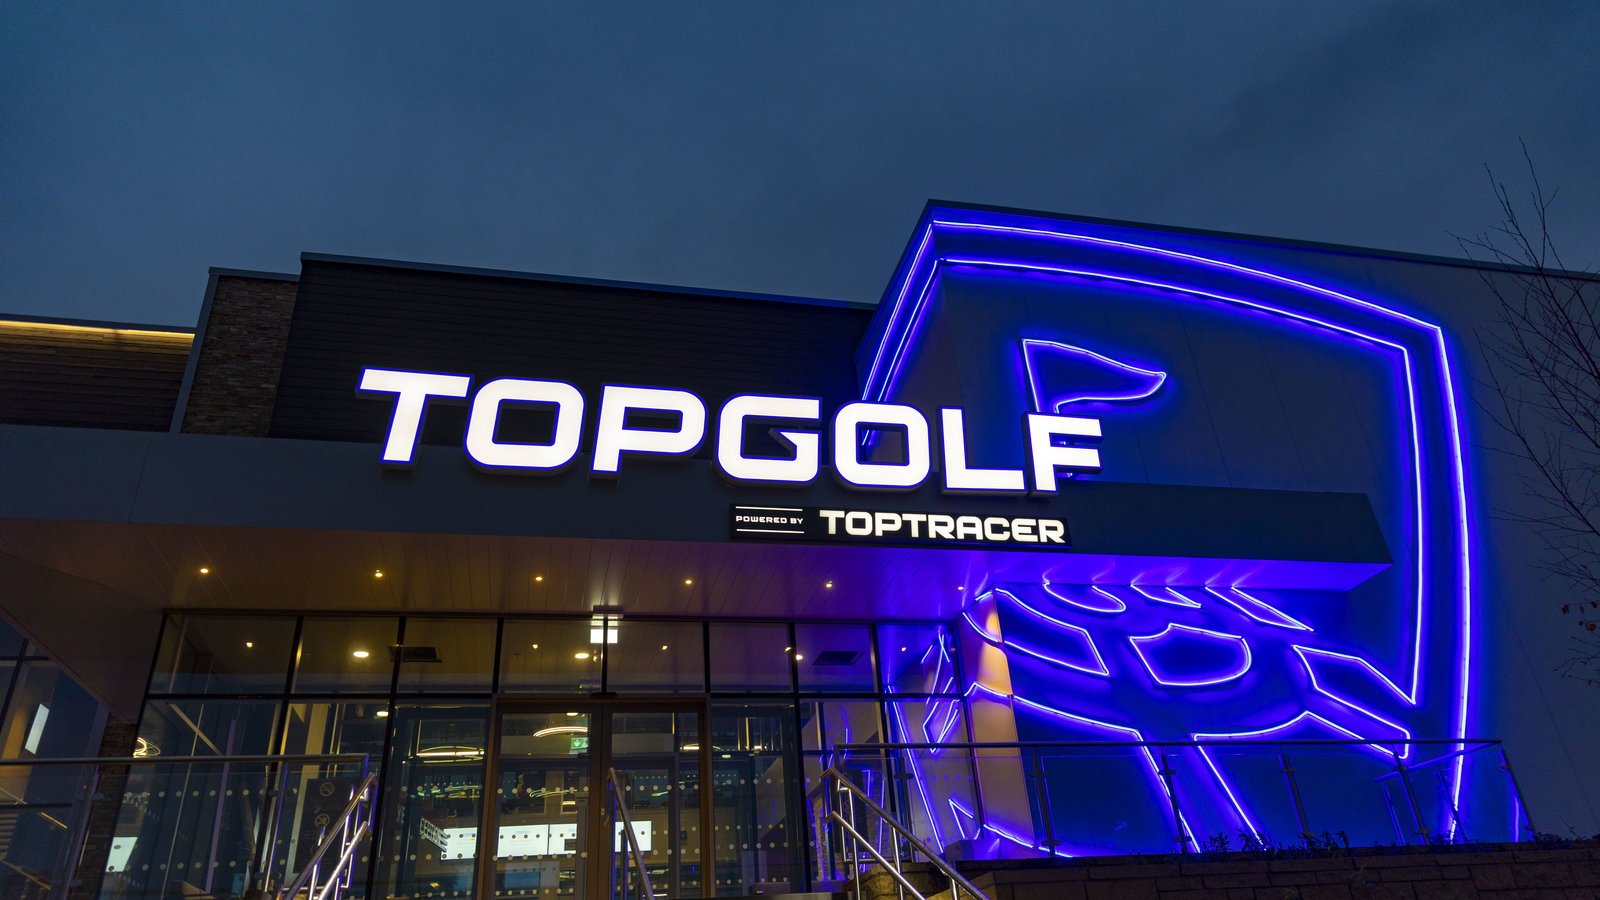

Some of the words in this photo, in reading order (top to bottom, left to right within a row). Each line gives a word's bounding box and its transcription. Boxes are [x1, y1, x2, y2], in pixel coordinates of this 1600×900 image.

[358, 367, 1104, 493] TOPGOLF
[735, 515, 788, 524] POWERED
[789, 517, 804, 525] BY
[819, 509, 1066, 544] TOPTRACER
